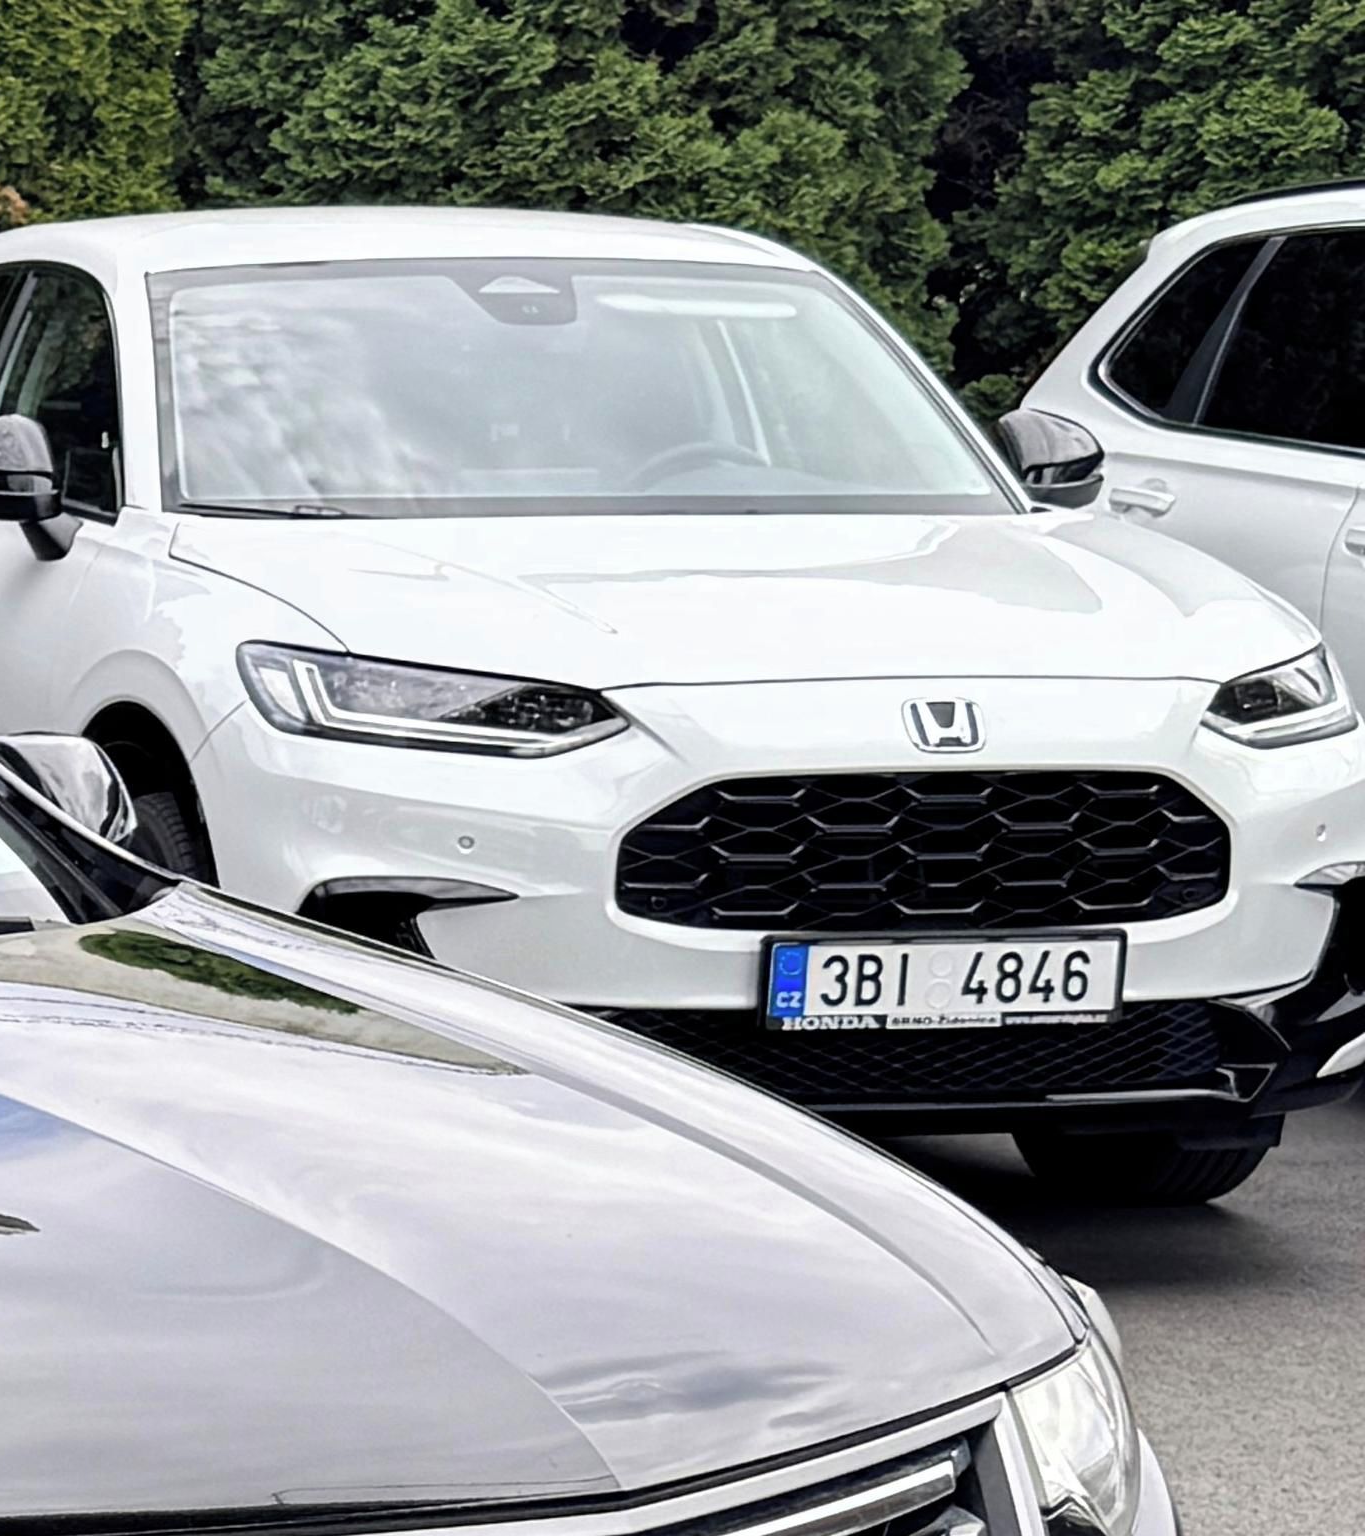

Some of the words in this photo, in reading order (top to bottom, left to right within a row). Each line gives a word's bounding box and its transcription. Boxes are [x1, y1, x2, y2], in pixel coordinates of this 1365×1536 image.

[820, 953, 910, 1006] 3BI
[961, 949, 1092, 1005] 4846
[776, 990, 803, 1008] CZ
[781, 1015, 881, 1031] HONDA
